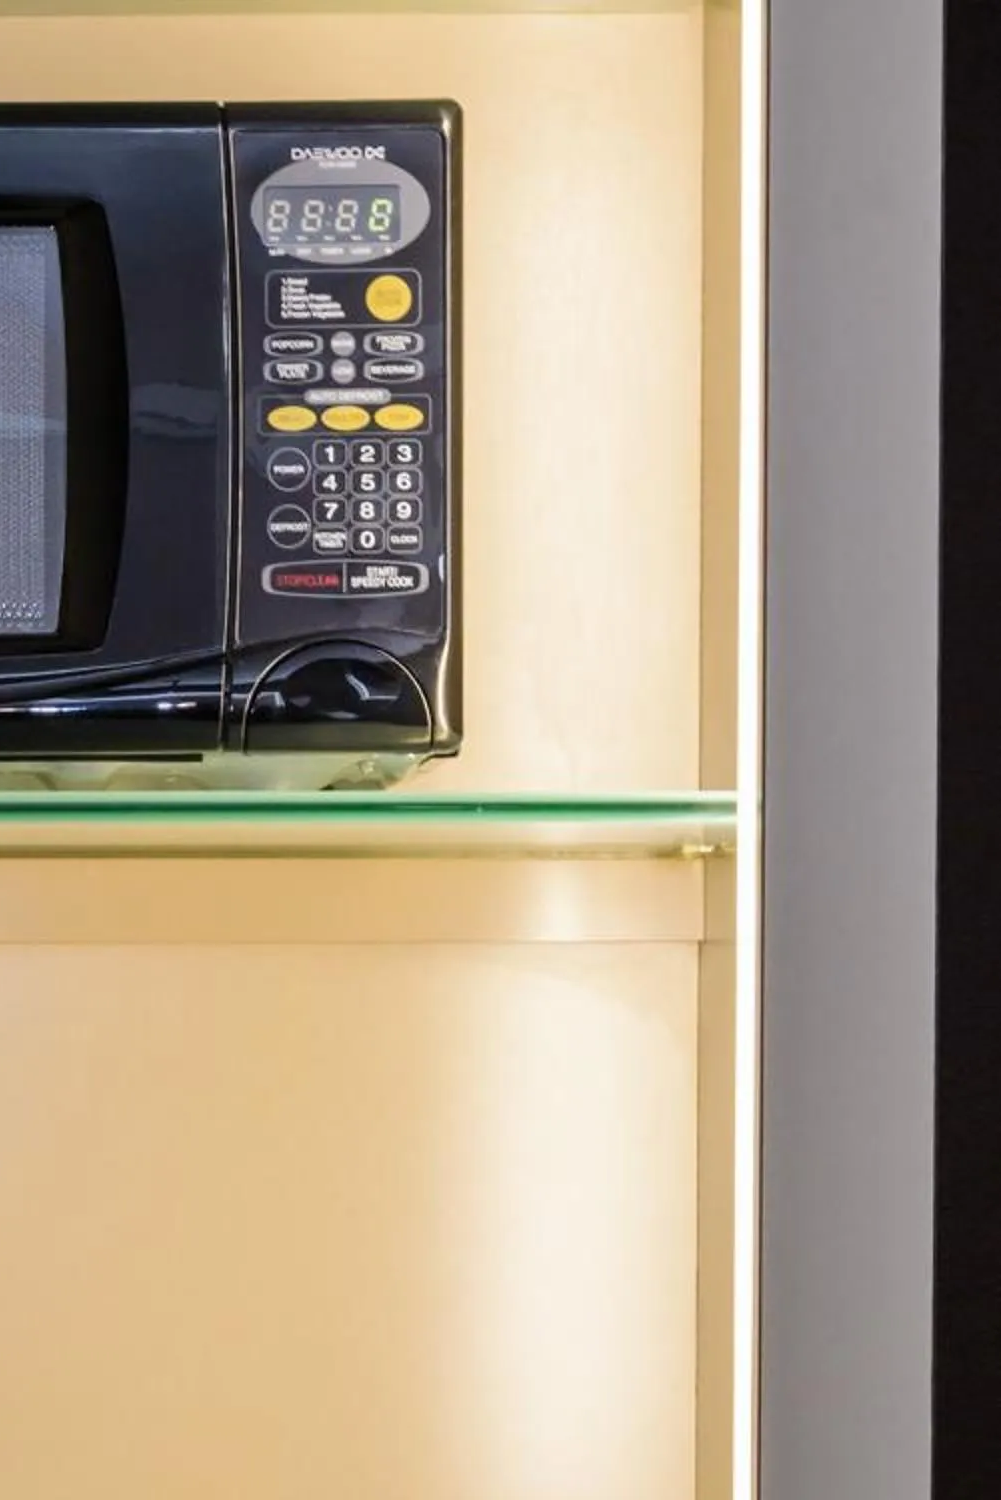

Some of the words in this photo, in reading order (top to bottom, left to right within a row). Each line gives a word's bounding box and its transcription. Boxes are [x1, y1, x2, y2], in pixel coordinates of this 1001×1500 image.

[291, 147, 363, 160] DAEWOO
[271, 340, 314, 349] POPCORN
[324, 445, 335, 463] 1
[359, 445, 375, 462] 2
[397, 444, 413, 462] 3
[322, 474, 338, 491] 4
[360, 473, 376, 491] 5
[396, 472, 412, 490] 6
[323, 502, 339, 520] 7
[359, 501, 375, 519] 8
[396, 501, 412, 519] 9
[360, 530, 376, 548] 0
[390, 535, 418, 544] CLOCK
[387, 576, 414, 588] COOK
